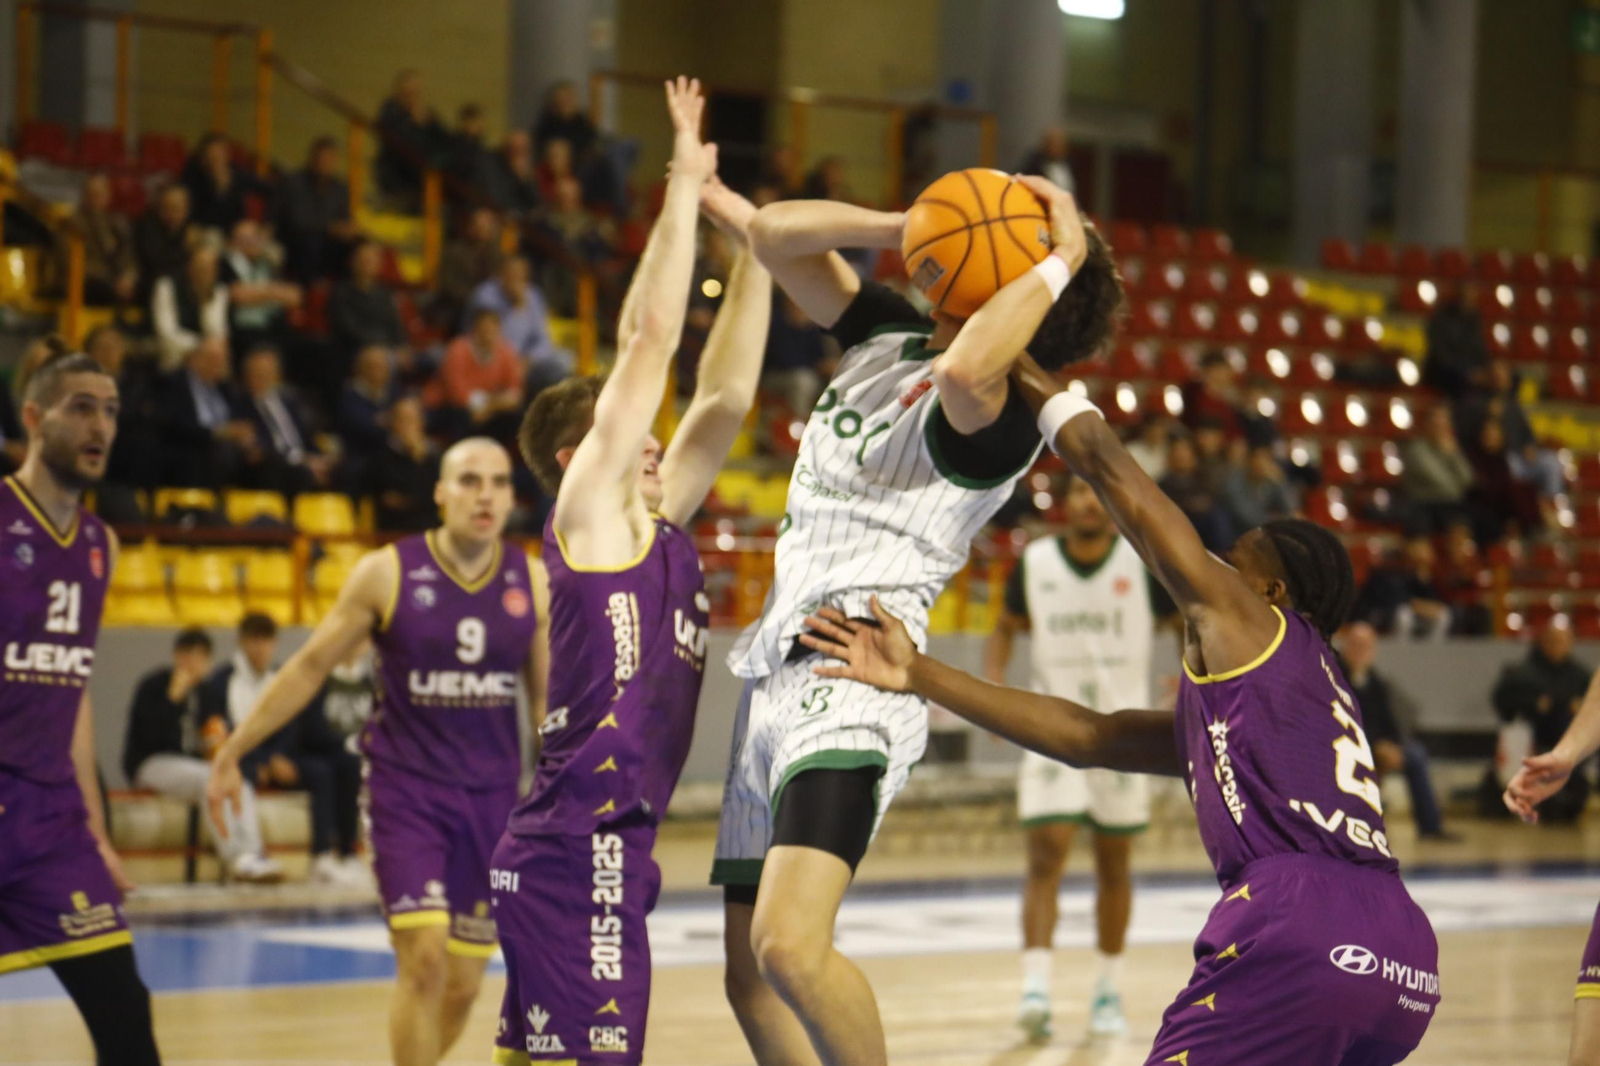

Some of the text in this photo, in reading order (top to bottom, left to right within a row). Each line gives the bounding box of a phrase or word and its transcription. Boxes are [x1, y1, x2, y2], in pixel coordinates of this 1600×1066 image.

[45, 579, 82, 634] 21
[4, 641, 95, 677] UEMC
[456, 617, 487, 664] 9
[408, 670, 518, 697] UEMC
[1331, 699, 1383, 817] 2
[590, 833, 623, 981] 2015-2025
[588, 1025, 629, 1049] CBC
